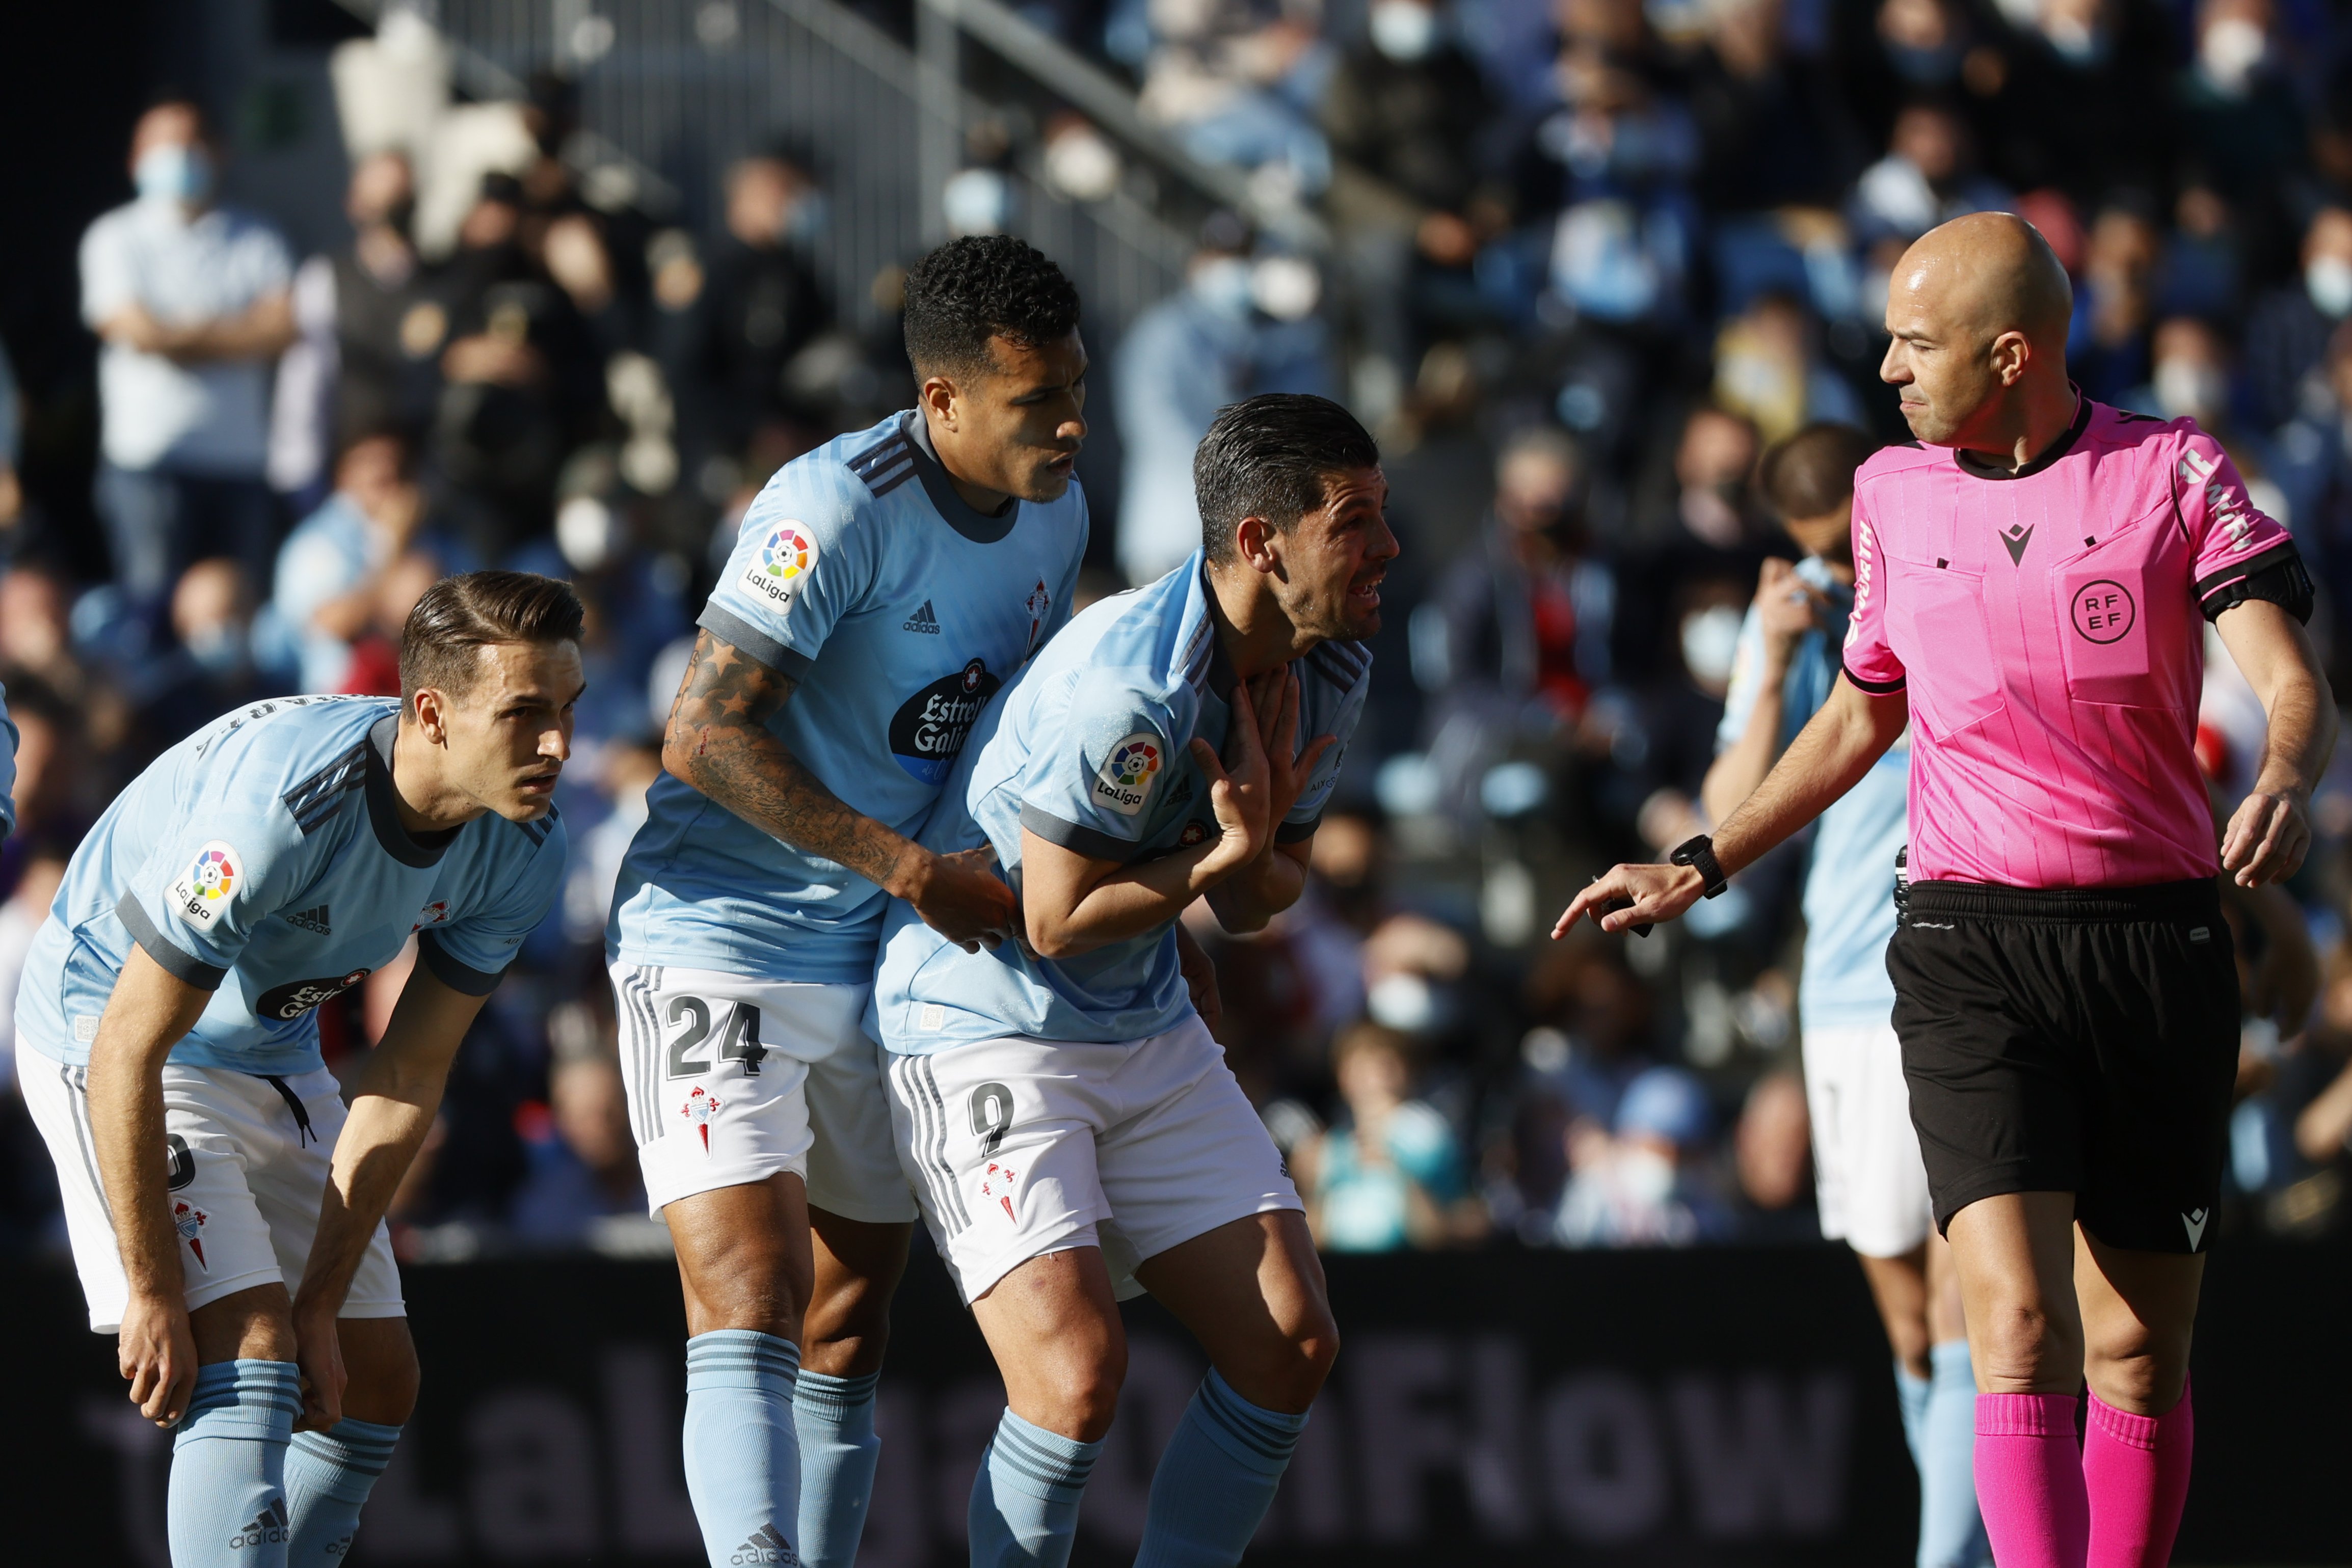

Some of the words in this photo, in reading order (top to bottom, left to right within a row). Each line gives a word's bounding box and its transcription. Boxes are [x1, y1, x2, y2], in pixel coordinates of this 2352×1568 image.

[746, 569, 790, 603] LaLiga
[903, 621, 941, 635] adidas
[919, 693, 987, 723] Estrell
[1097, 781, 1142, 805] LaLiga
[175, 881, 211, 920] LaLiga
[286, 914, 331, 936] adidas
[665, 995, 768, 1082] 24
[967, 1082, 1014, 1158] 9
